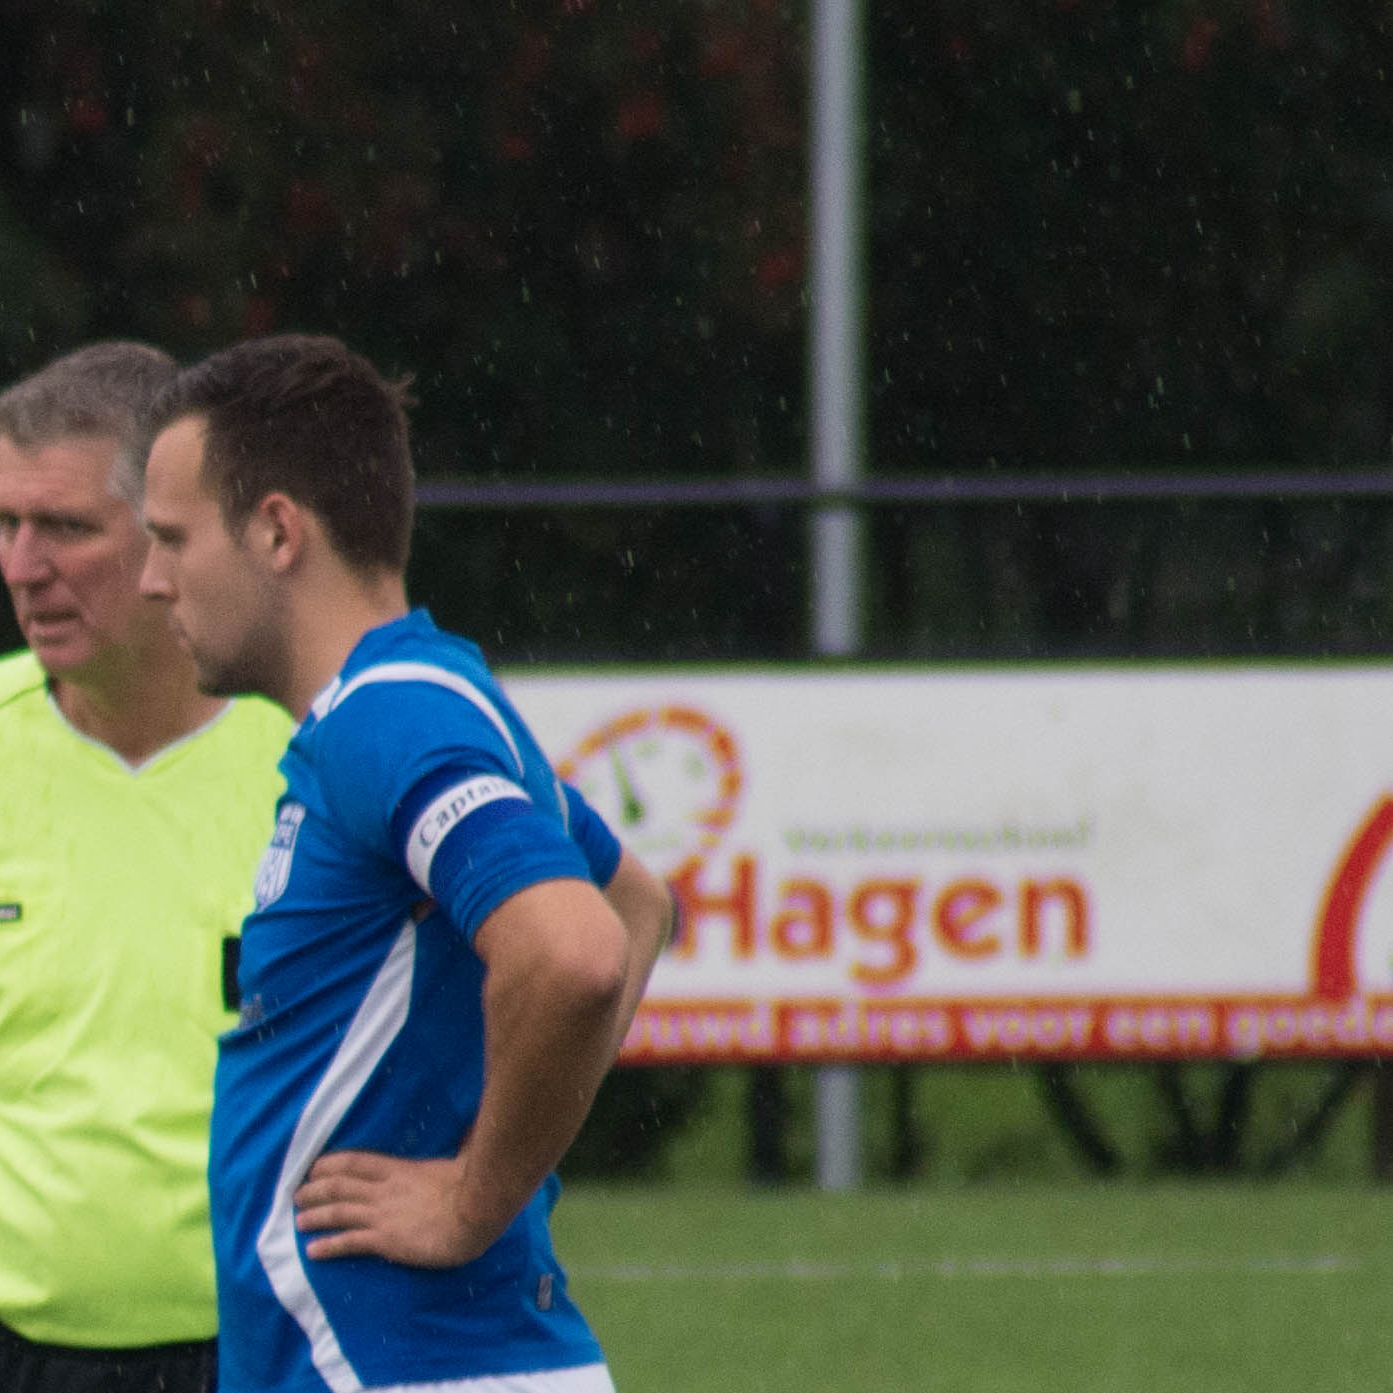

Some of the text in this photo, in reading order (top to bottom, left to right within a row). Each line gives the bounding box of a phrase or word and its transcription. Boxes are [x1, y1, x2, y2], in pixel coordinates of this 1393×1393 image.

[671, 853, 1090, 986] Hagen
[962, 1007, 1095, 1049] voor
[1108, 1007, 1214, 1049] een
